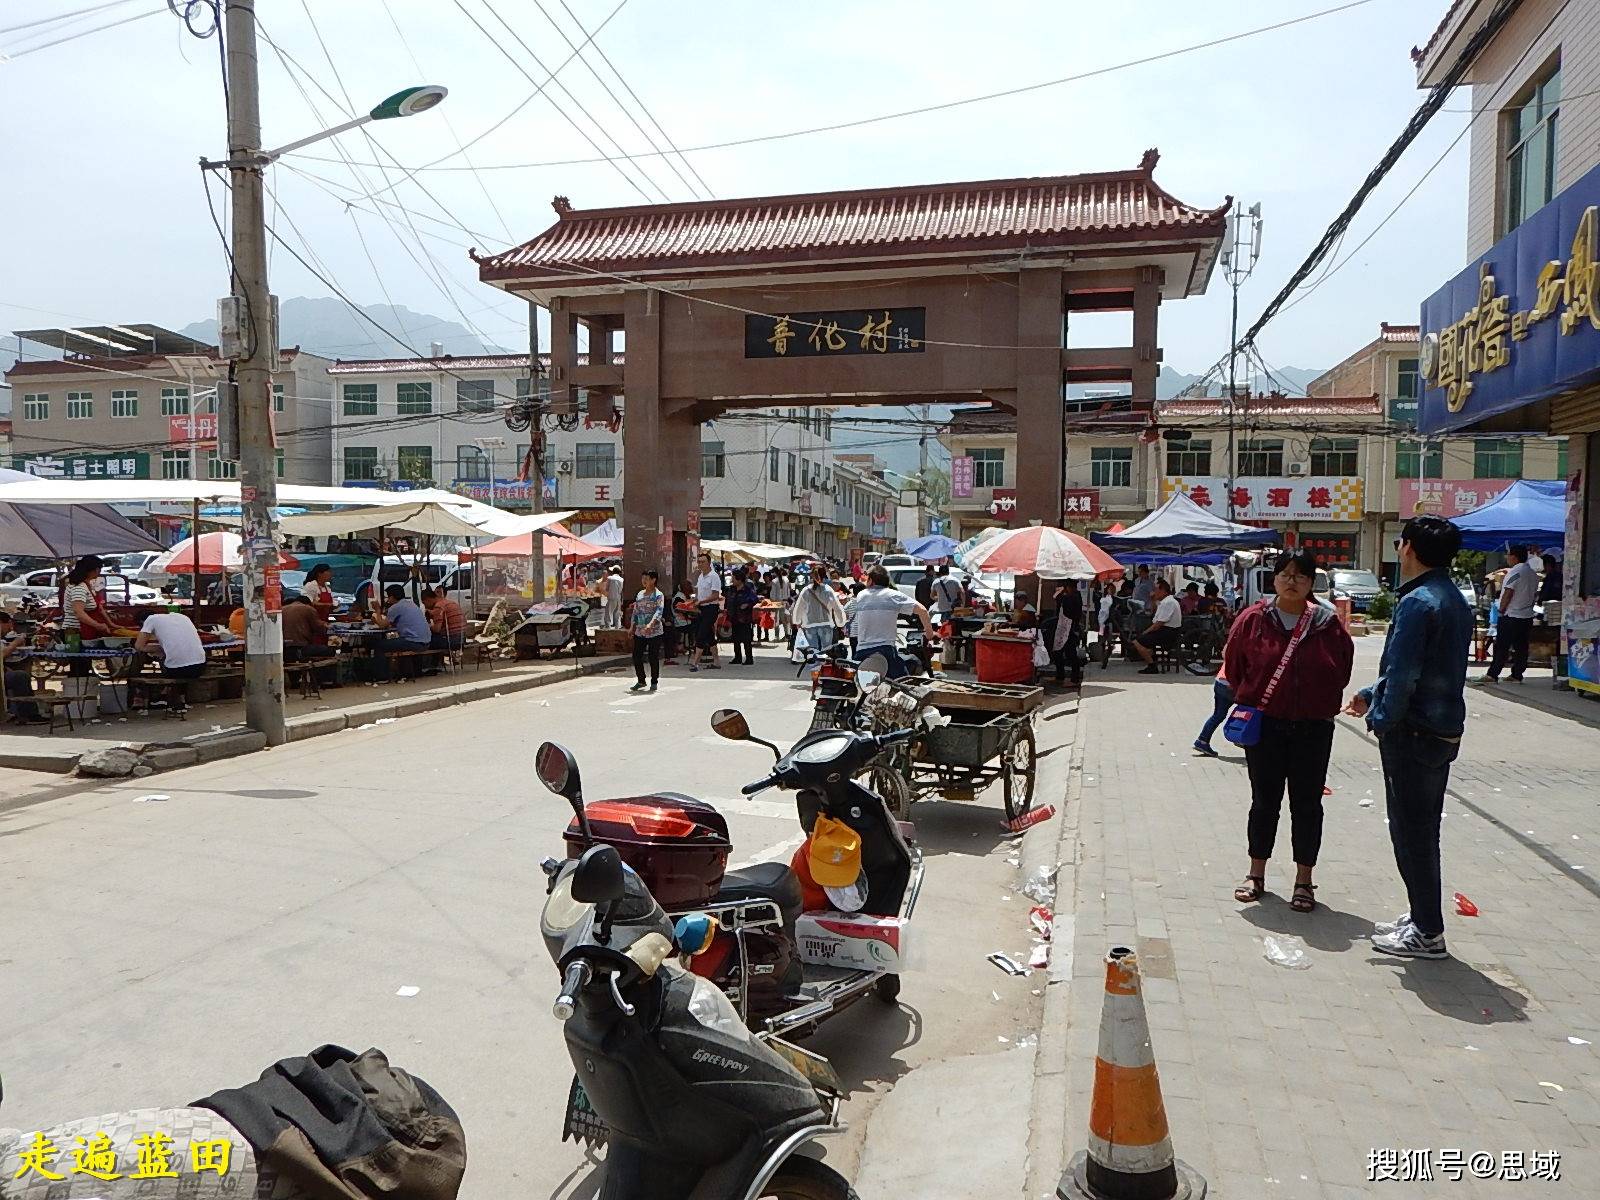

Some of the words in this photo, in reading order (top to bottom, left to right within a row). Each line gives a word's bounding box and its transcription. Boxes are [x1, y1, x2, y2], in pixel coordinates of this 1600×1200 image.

[767, 311, 892, 355] 普化村
[72, 458, 136, 476] 雷士照明
[595, 485, 610, 501] 王
[1063, 496, 1092, 512] 夹馍
